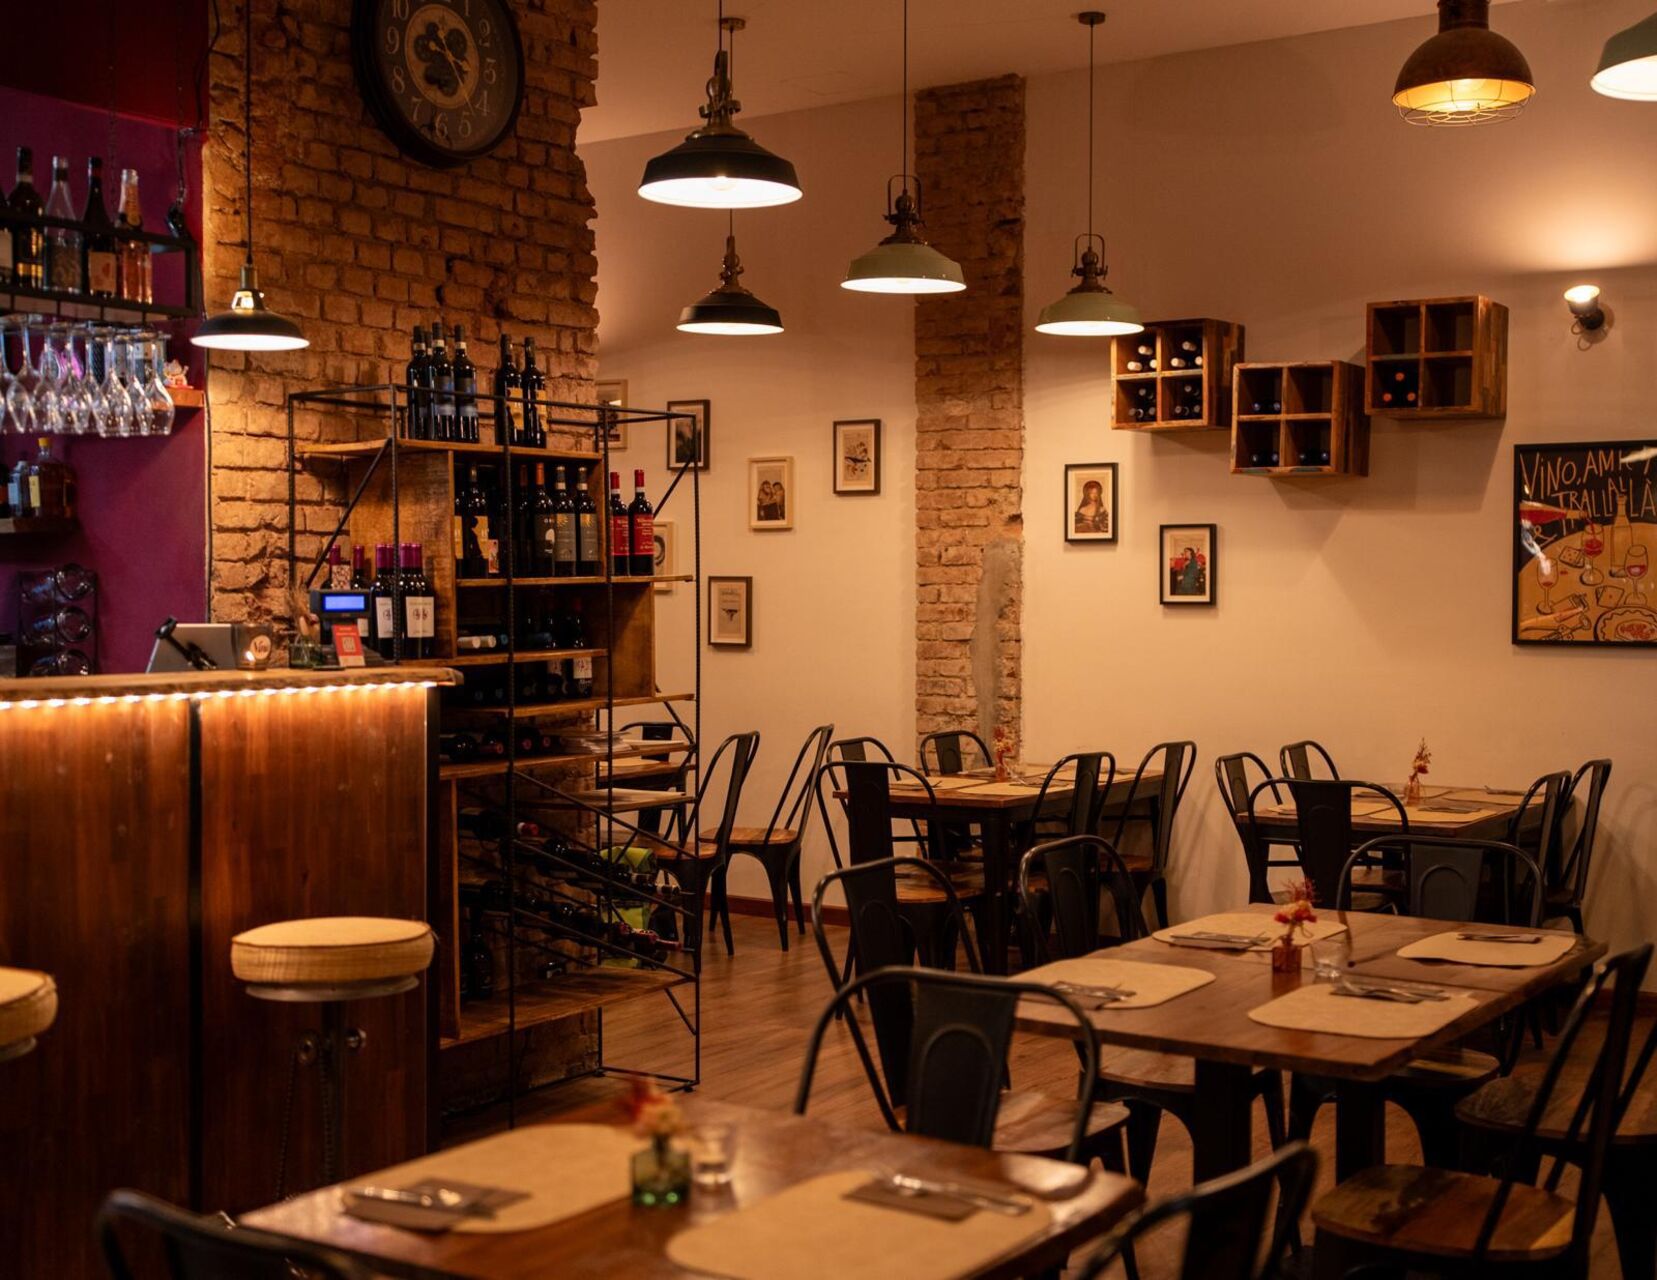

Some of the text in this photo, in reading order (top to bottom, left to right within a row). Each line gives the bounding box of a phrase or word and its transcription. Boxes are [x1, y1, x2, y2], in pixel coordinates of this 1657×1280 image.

[385, 26, 400, 55] 9
[391, 65, 405, 95] 8
[483, 57, 497, 85] 3
[411, 96, 425, 122] 7
[475, 90, 490, 117] 4
[435, 111, 449, 139] 6
[458, 112, 472, 138] 5
